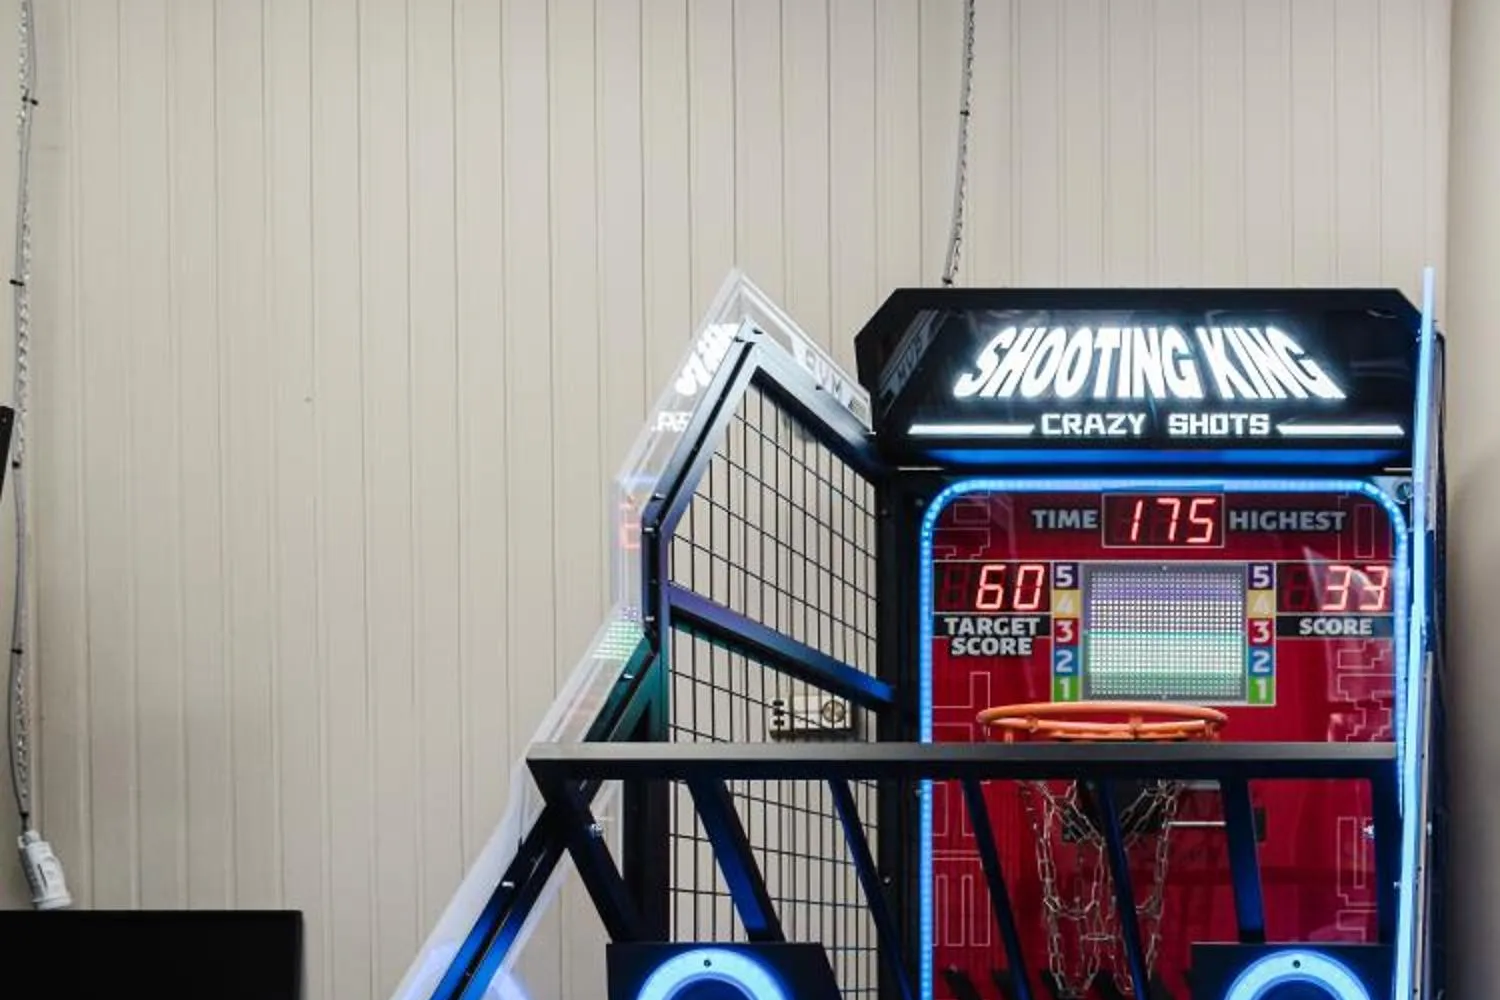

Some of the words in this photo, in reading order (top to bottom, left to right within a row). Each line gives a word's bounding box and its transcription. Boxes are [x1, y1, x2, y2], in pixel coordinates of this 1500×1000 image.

[953, 325, 1202, 400] SHOOTING
[1194, 325, 1348, 400] KING
[1040, 412, 1146, 436] CRAZY
[1167, 412, 1270, 436] SHOTS
[1031, 508, 1098, 529] TIME
[1228, 510, 1347, 532] HIGHEST
[1128, 496, 1217, 544] 175
[975, 563, 1044, 612] 60
[1055, 565, 1074, 588] 5
[1252, 565, 1271, 588] 5
[1320, 564, 1389, 612] 33
[944, 617, 1040, 637] TARGET
[1055, 620, 1074, 644] 3
[1252, 620, 1271, 644] 3
[1298, 617, 1373, 636] SCORE
[950, 636, 1033, 657] SCORE
[1055, 649, 1074, 673] 2
[1252, 649, 1271, 673] 2
[1058, 677, 1071, 700] 1
[1255, 677, 1268, 700] 1
